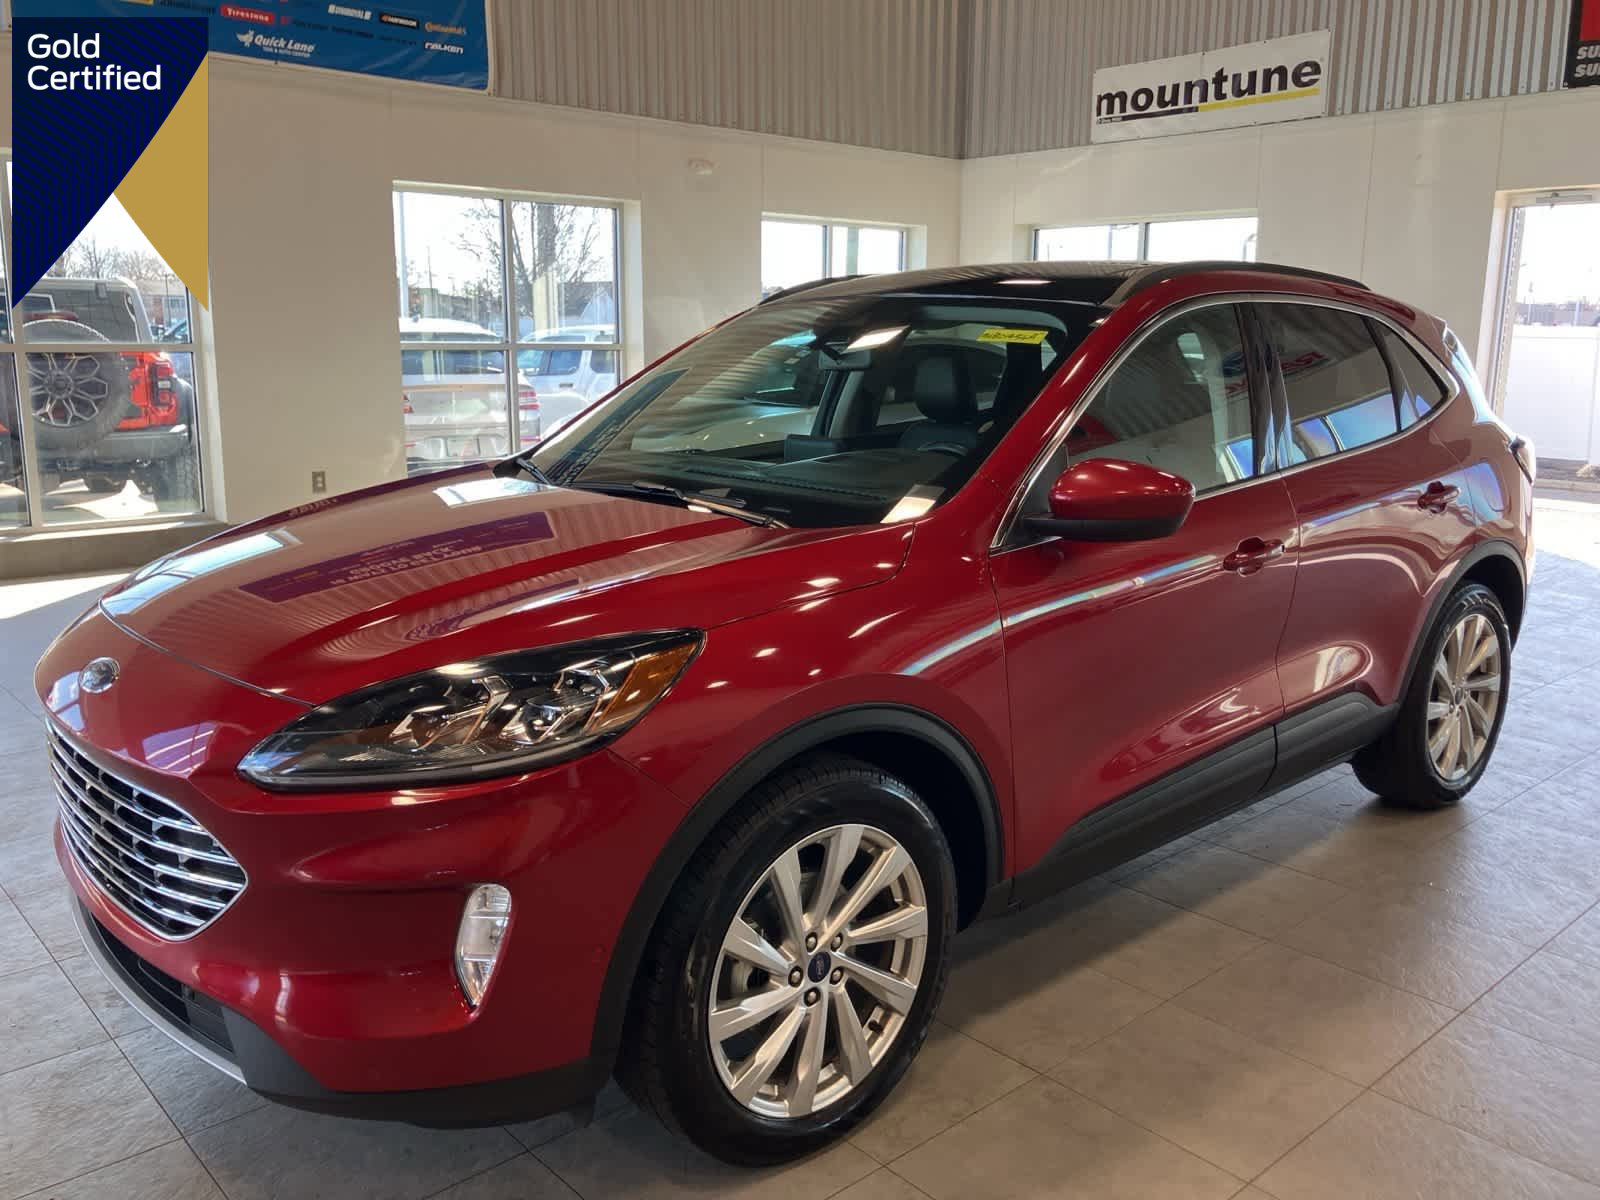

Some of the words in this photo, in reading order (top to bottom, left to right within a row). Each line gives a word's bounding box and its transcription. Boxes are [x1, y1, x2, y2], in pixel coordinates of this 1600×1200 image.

[254, 34, 286, 48] Quick
[287, 39, 315, 53] Lane
[1576, 45, 1600, 59] SU
[1574, 62, 1600, 78] SU
[1096, 60, 1322, 117] mountune
